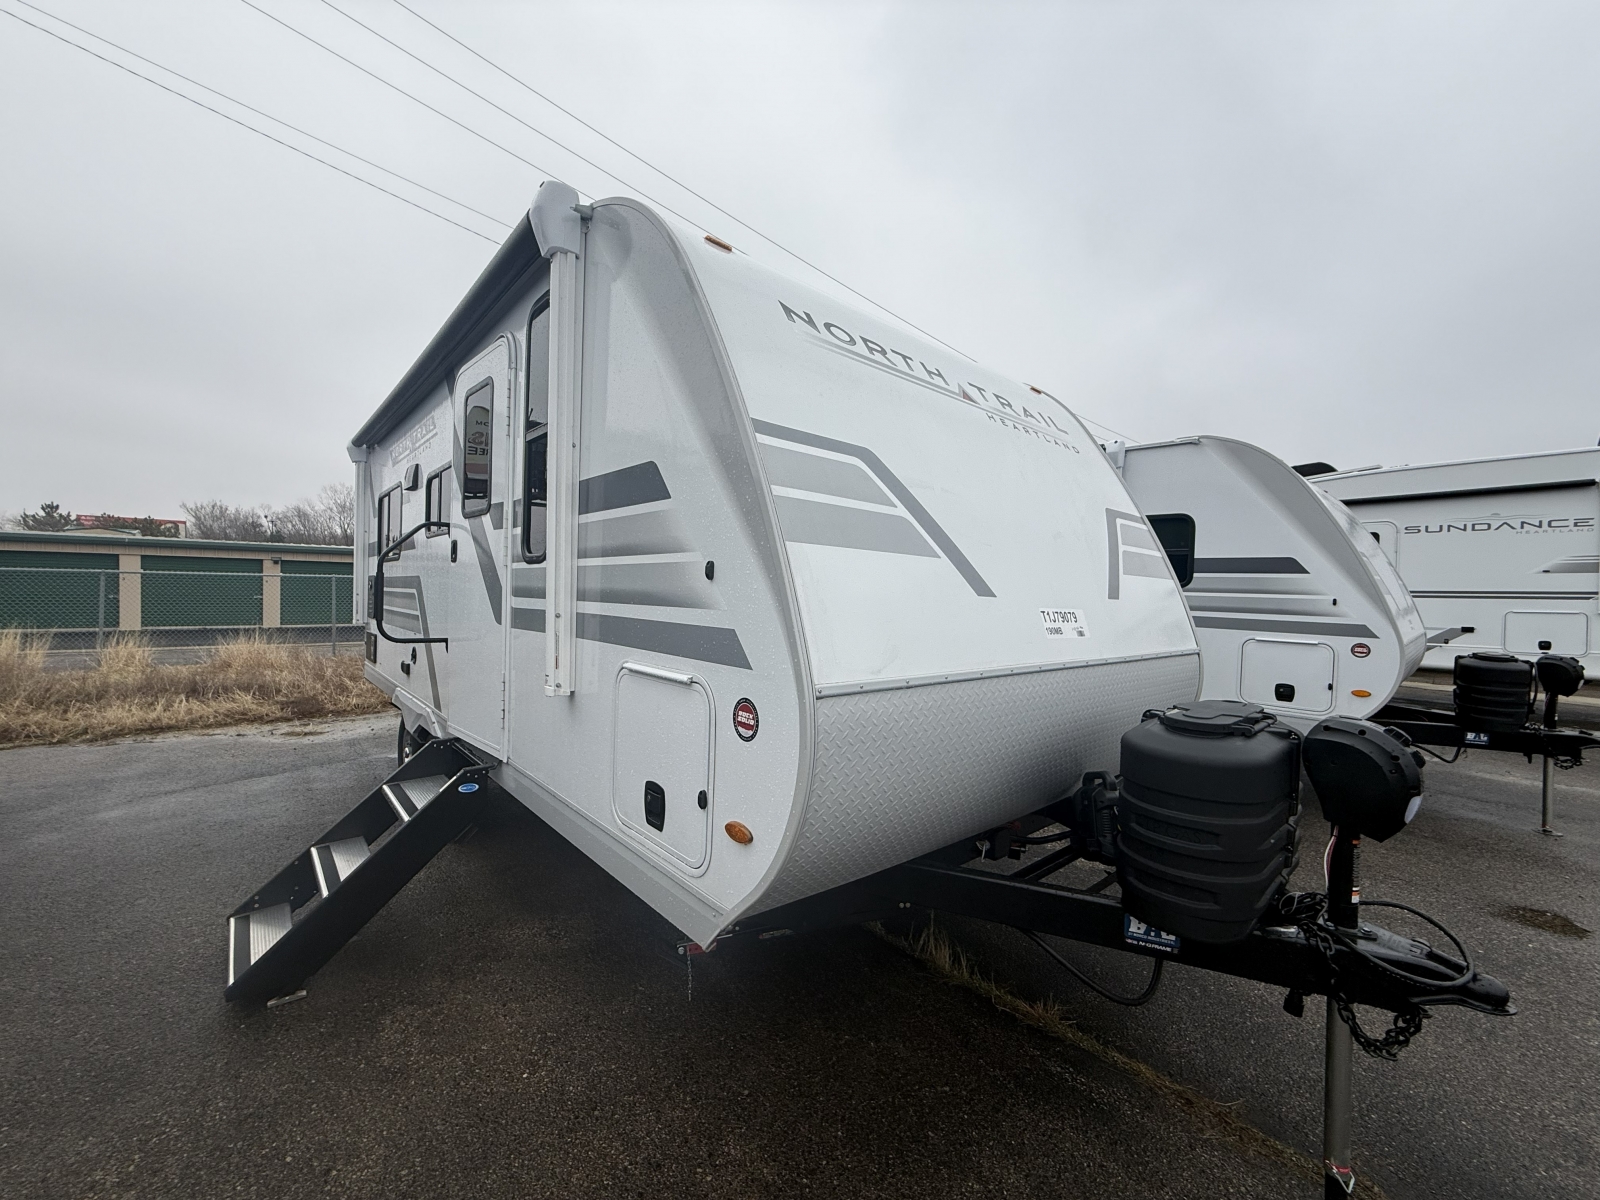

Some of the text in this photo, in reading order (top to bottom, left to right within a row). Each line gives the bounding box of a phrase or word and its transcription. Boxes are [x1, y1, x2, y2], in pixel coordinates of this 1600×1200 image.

[777, 299, 1068, 434] NORTH TRAIL
[985, 413, 1079, 454] HEARTLAND
[1404, 517, 1595, 535] SUNDANCE
[1040, 610, 1078, 623] T1J79079
